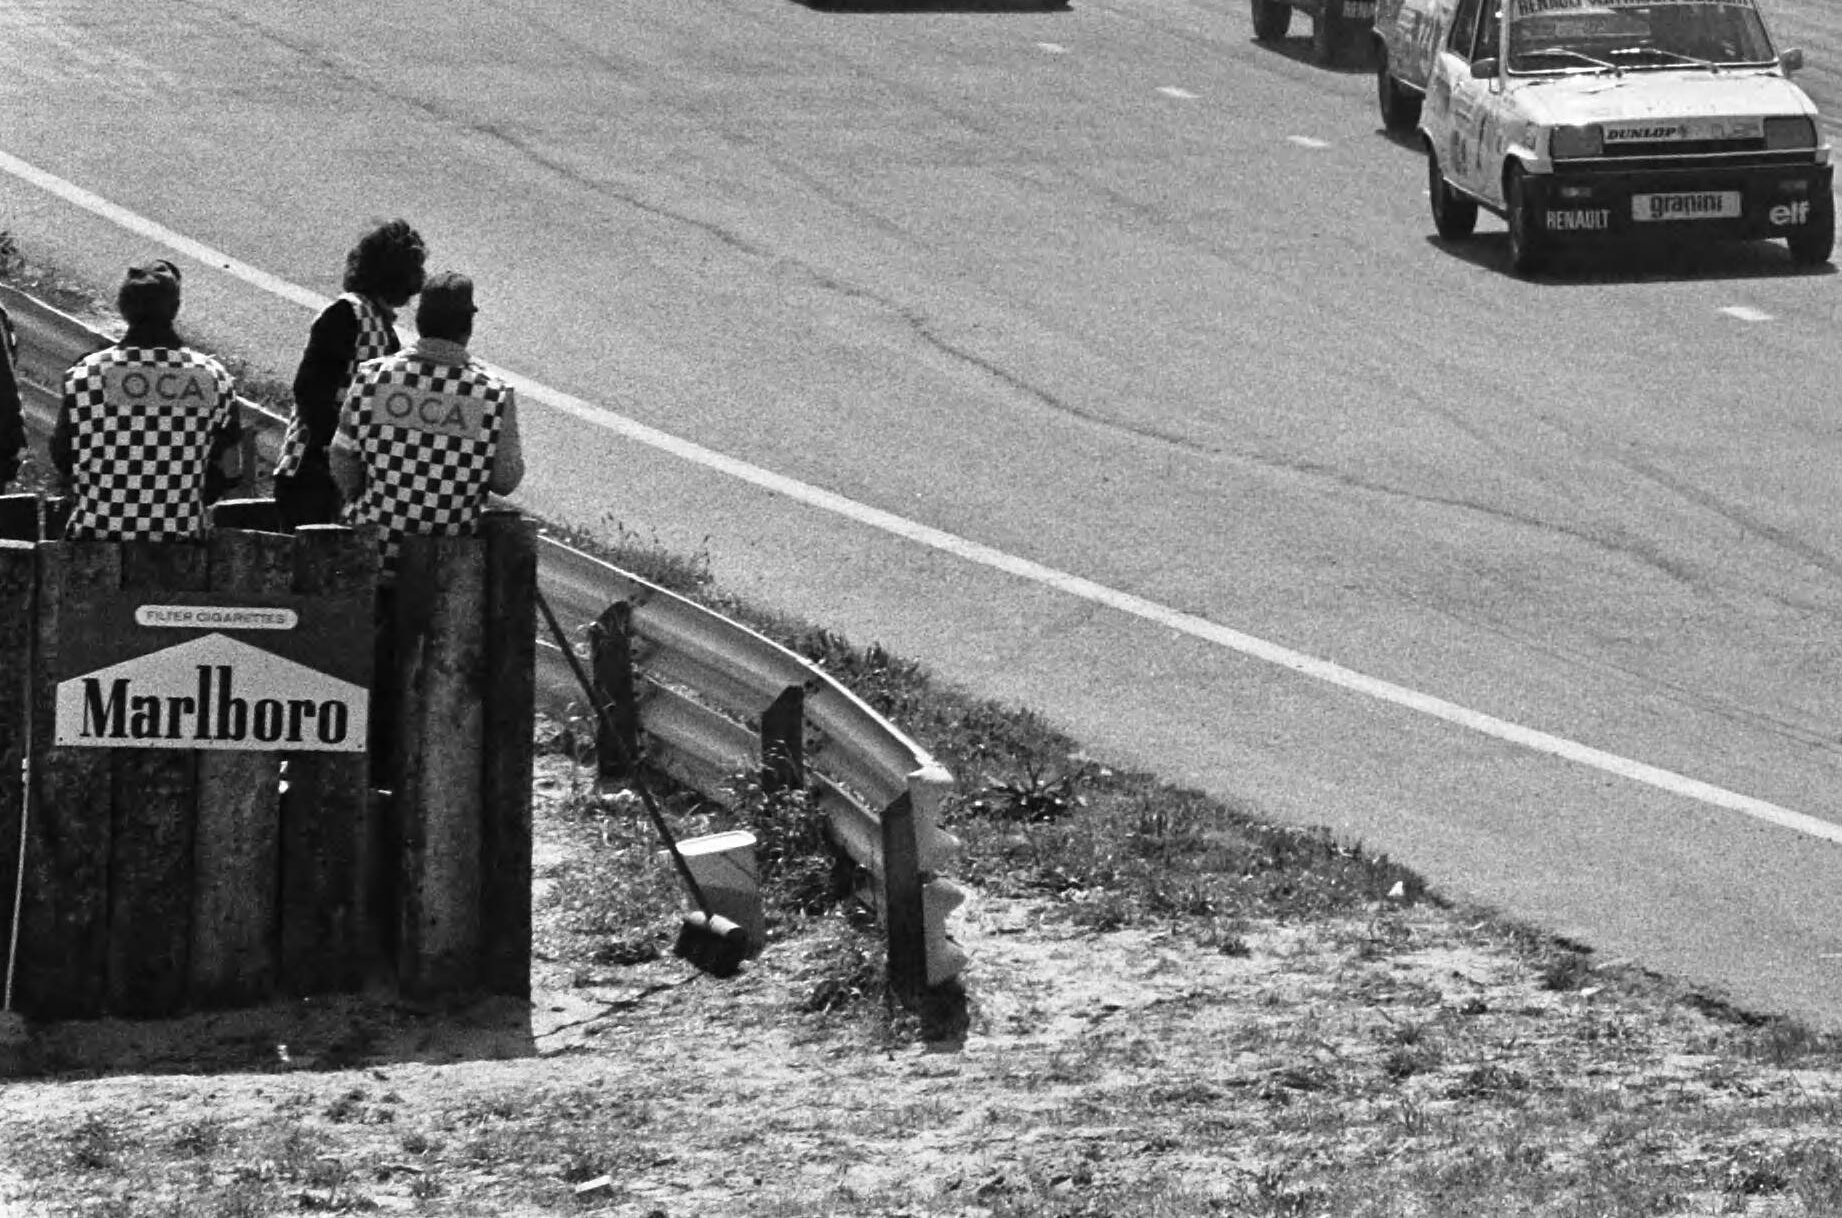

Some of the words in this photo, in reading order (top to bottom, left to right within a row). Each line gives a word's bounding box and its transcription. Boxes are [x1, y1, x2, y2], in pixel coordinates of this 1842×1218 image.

[1606, 126, 1677, 141] DUNLOP
[1546, 208, 1612, 230] RENAULT
[1649, 193, 1724, 219] granini
[1768, 200, 1811, 226] elf
[120, 371, 205, 401] OCA
[385, 391, 467, 431] OCA
[146, 610, 193, 623] FILTER
[195, 611, 286, 625] CIGARETTES
[79, 664, 350, 745] Marlboro
